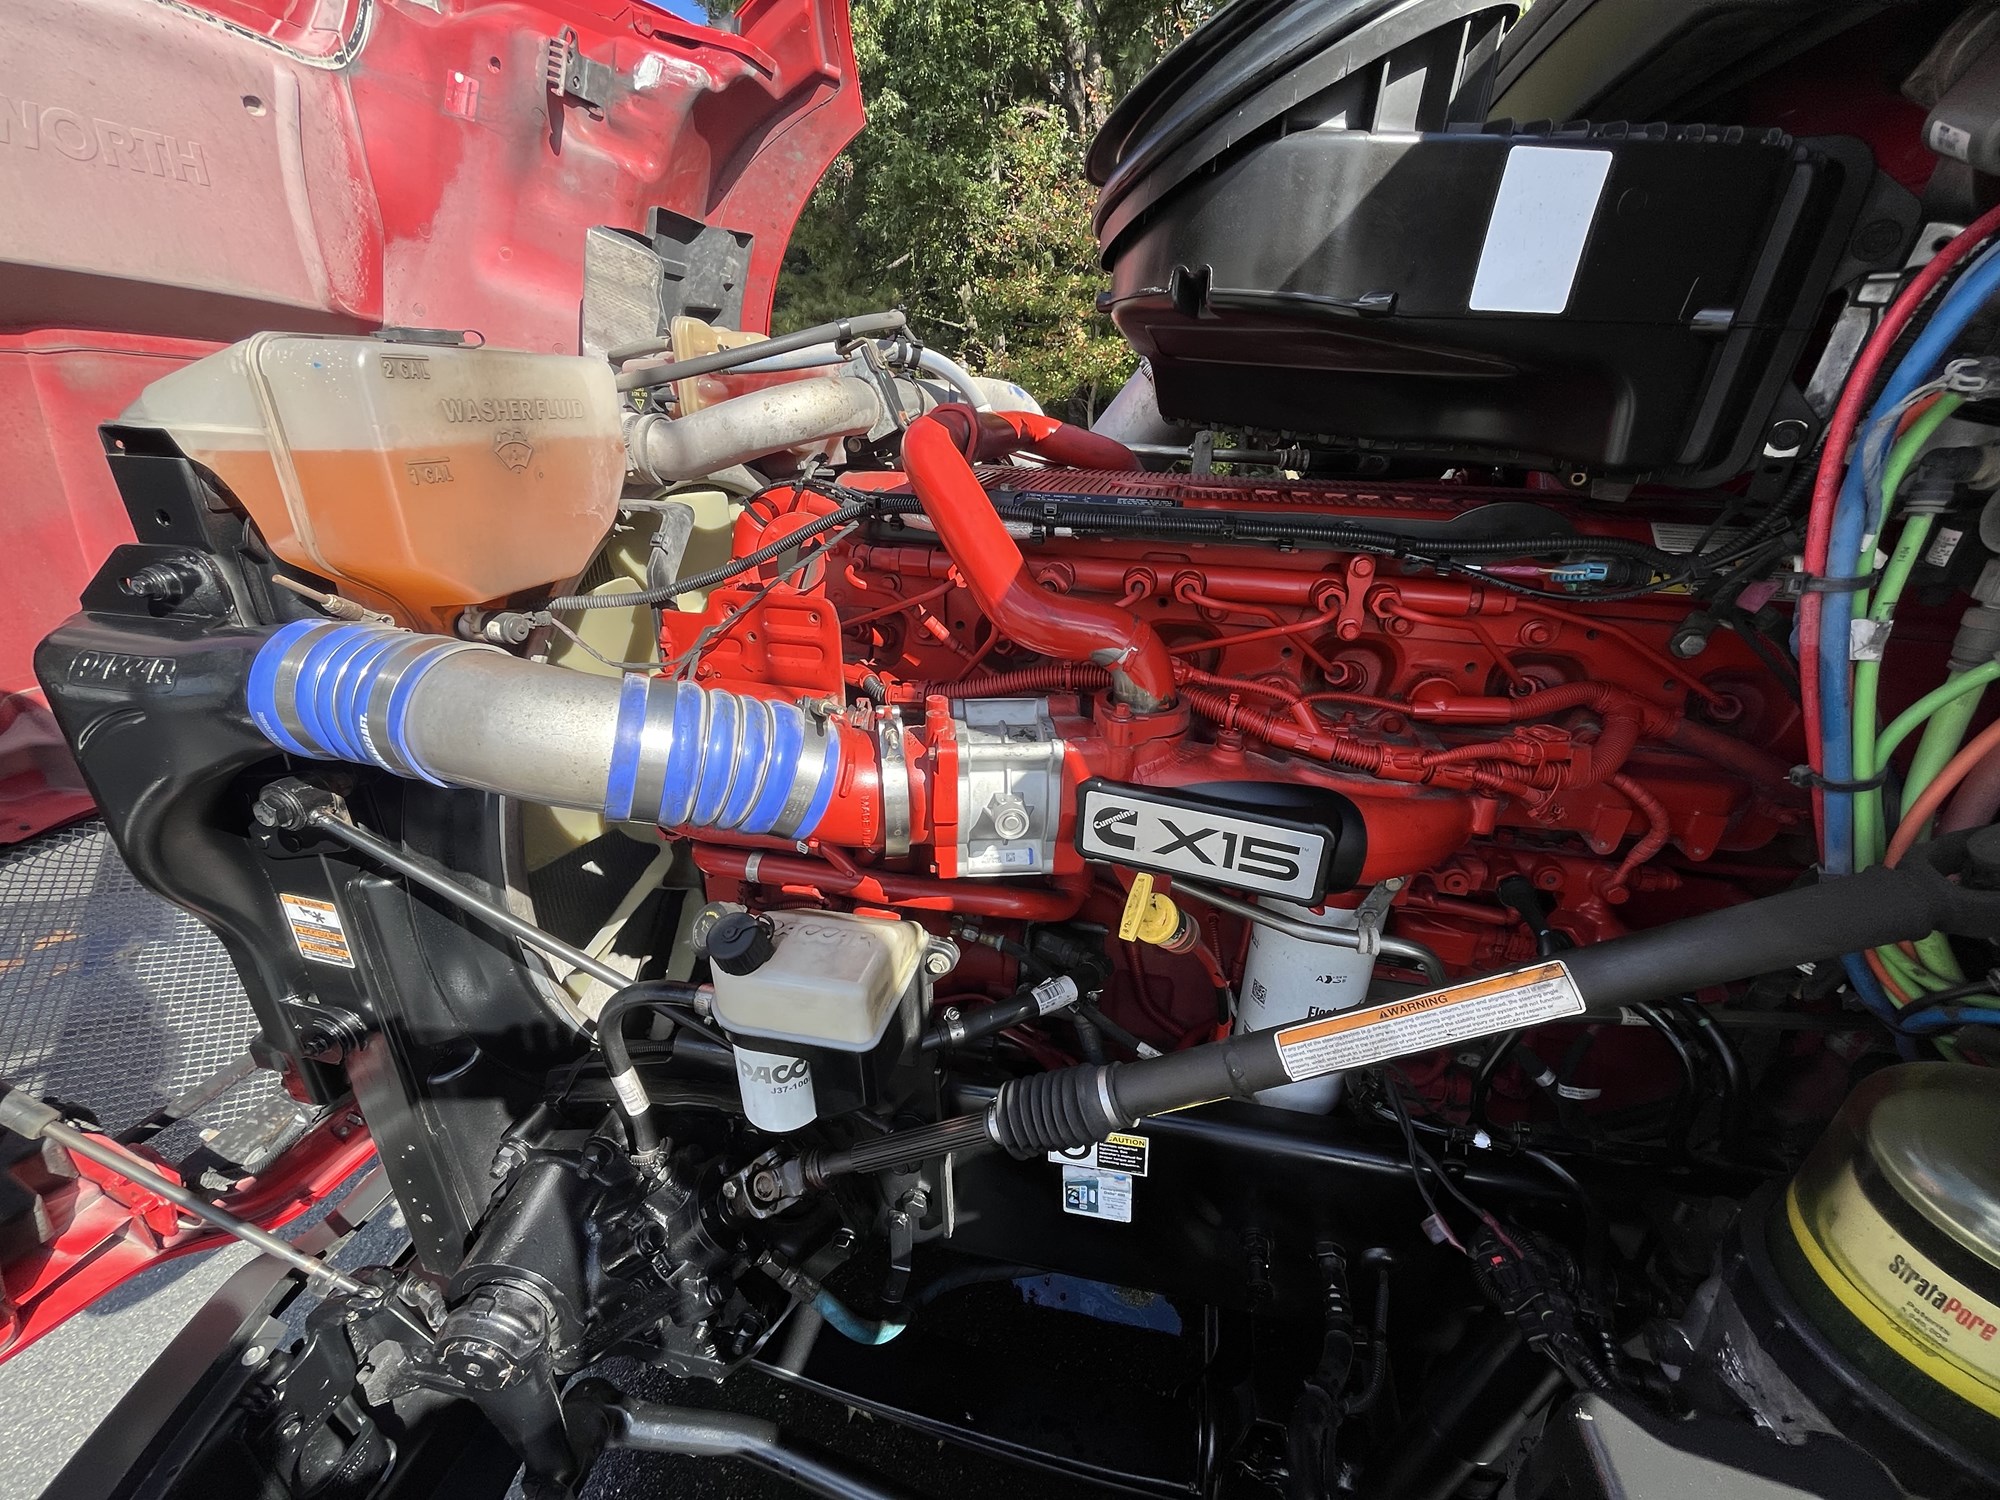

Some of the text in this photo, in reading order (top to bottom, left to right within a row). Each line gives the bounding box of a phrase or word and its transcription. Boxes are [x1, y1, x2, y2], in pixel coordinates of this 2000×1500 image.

[384, 360, 431, 379] 2 GAL
[441, 399, 584, 422] WASHER FLUID
[408, 466, 454, 485] 1 GAL
[1151, 817, 1301, 882] X15
[1387, 994, 1448, 1016] WARNING
[771, 1077, 810, 1095] J37-100
[1888, 1254, 1998, 1341] StrataPore
